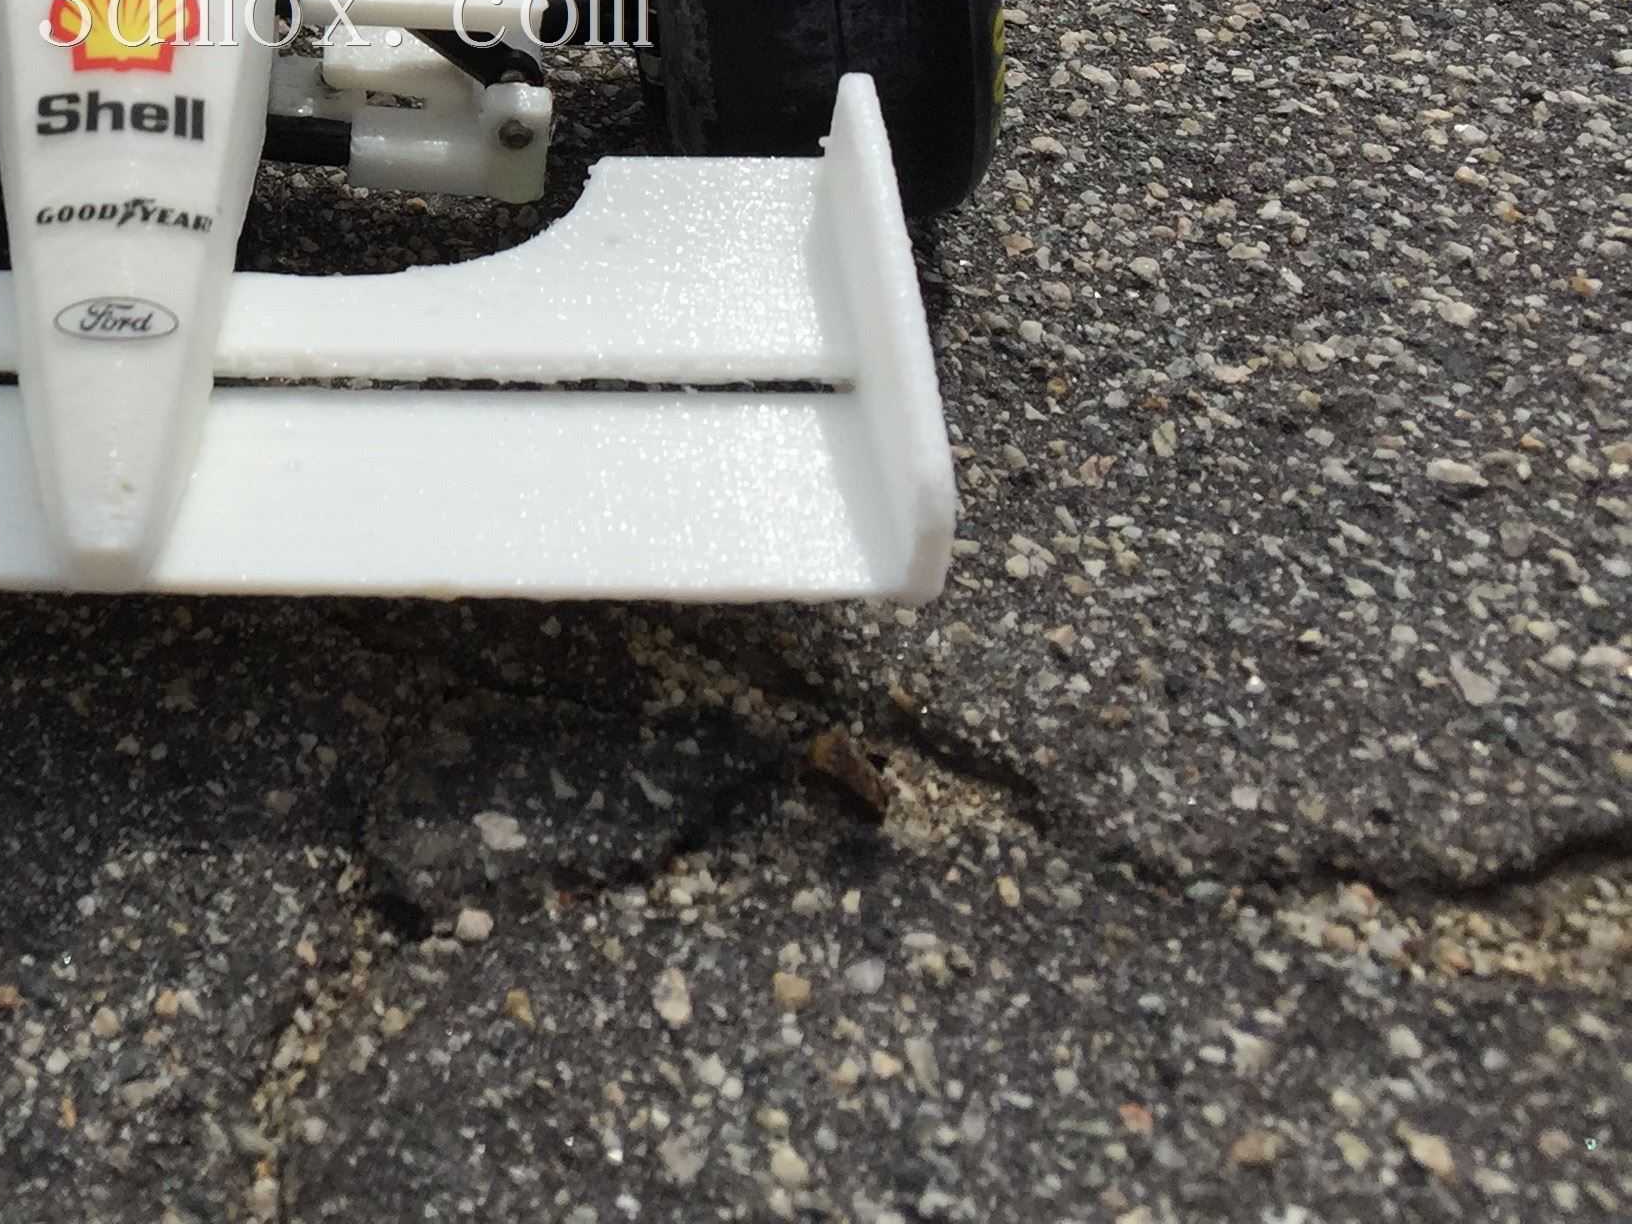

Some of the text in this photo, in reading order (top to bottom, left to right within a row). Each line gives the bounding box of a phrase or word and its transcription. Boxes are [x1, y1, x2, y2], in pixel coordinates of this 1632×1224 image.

[36, 89, 206, 141] Shell
[36, 196, 213, 233] GOODYEAR
[76, 302, 157, 335] Ford
